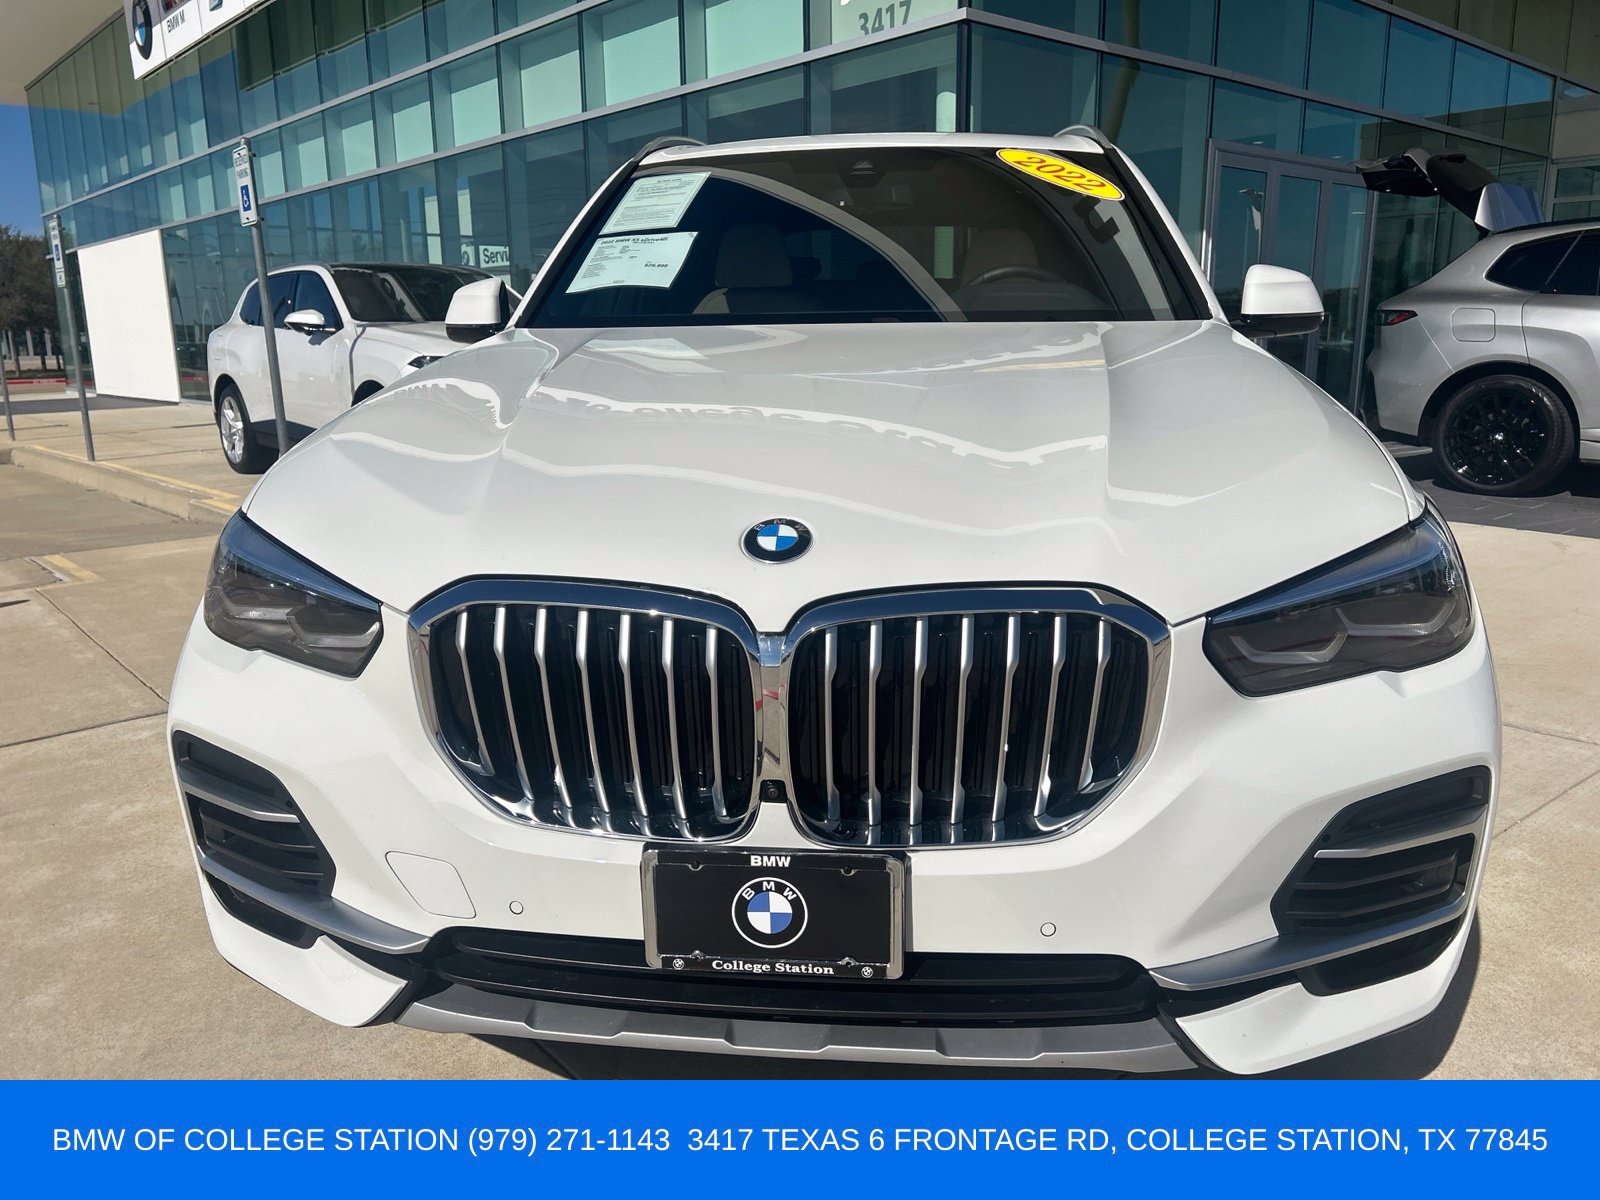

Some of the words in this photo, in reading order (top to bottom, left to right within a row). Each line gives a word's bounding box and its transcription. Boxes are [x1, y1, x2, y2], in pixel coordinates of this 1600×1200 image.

[166, 13, 180, 33] BMW
[179, 9, 186, 25] M
[858, 0, 912, 35] 3417
[1013, 156, 1106, 190] 2022
[750, 855, 791, 868] BMW
[741, 880, 797, 901] BMW
[712, 959, 771, 973] College
[774, 962, 835, 976] Station
